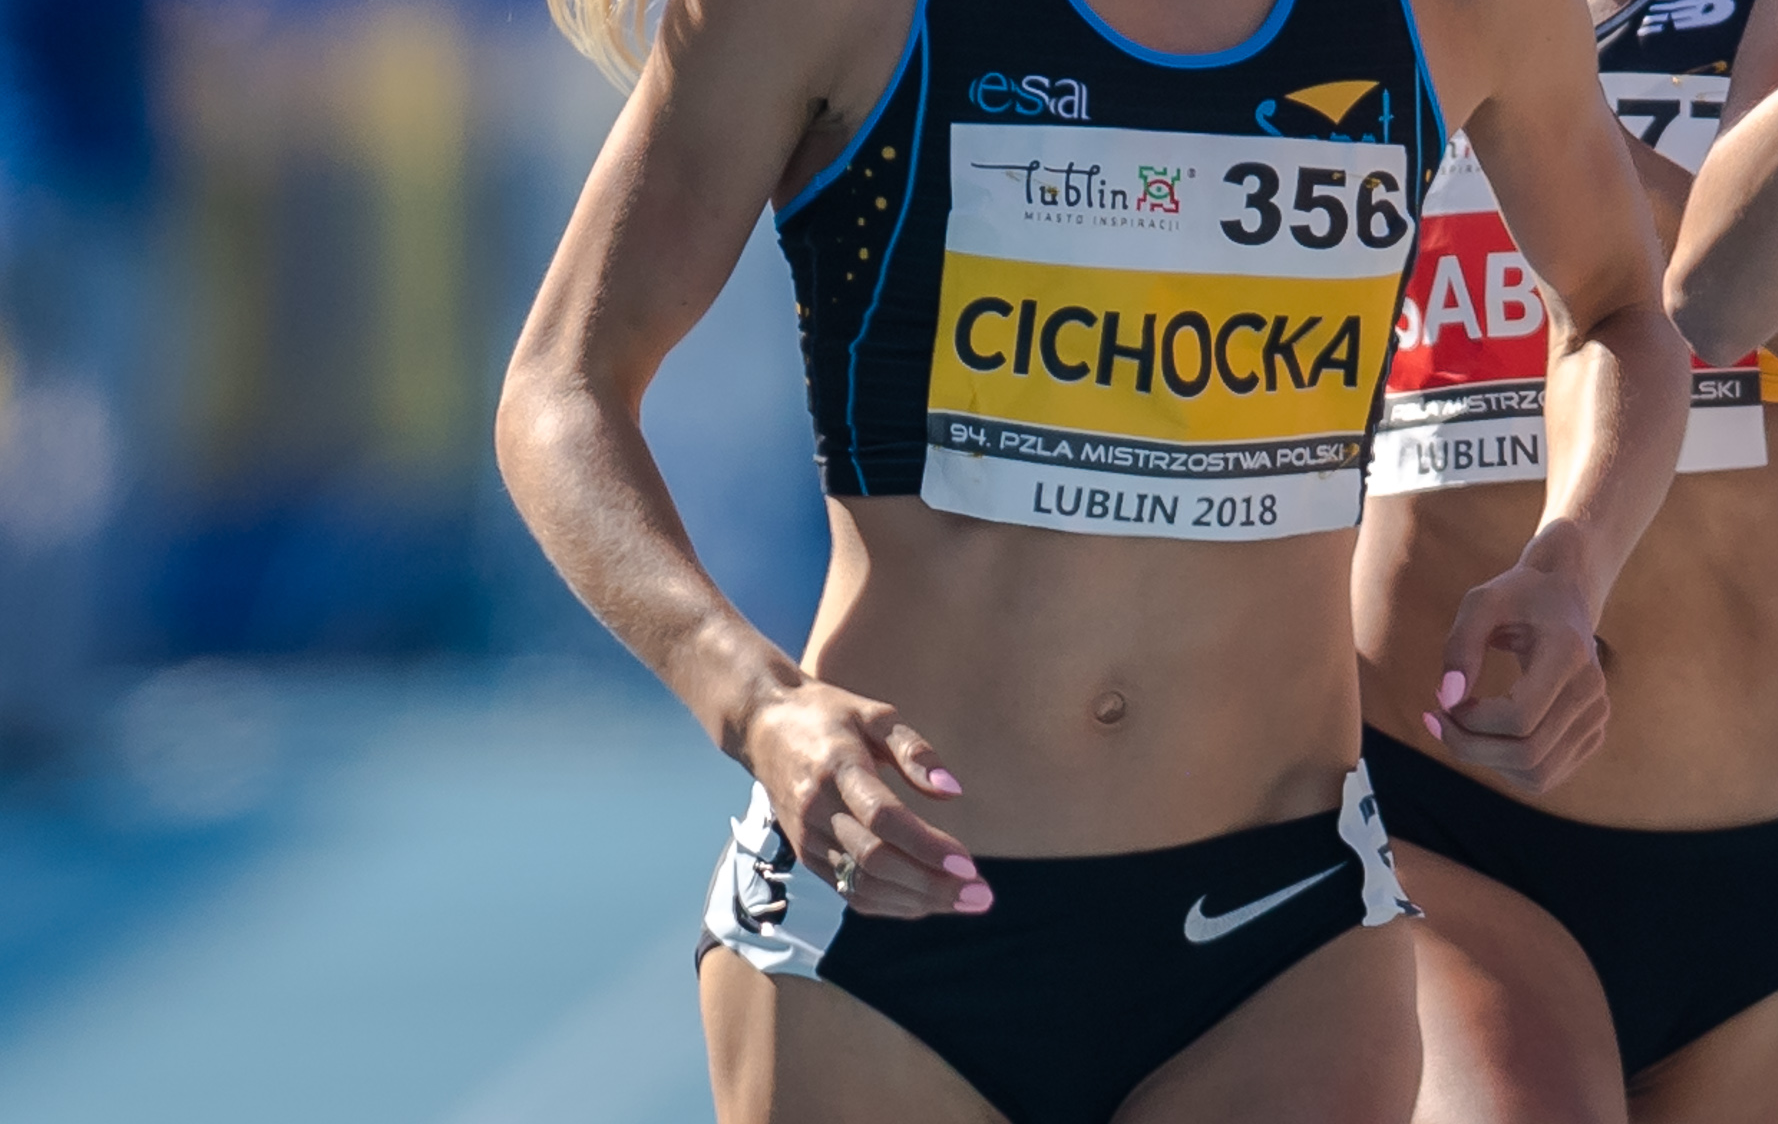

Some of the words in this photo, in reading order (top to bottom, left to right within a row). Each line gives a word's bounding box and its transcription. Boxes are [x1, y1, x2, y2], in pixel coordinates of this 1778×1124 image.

[1024, 211, 1085, 225] MIASTO
[1093, 217, 1181, 231] INSPIRACJI
[1219, 162, 1408, 250] 356
[953, 296, 1363, 399] CICHOCKA
[949, 423, 992, 449] 94.
[1000, 431, 1074, 459] PZLA
[1079, 443, 1271, 473] MISTRZOSTWA
[1277, 442, 1344, 469] POLSKI
[1417, 433, 1540, 475] LUBLIN
[1032, 482, 1179, 526] LUBLIN
[1191, 493, 1279, 528] 2018
